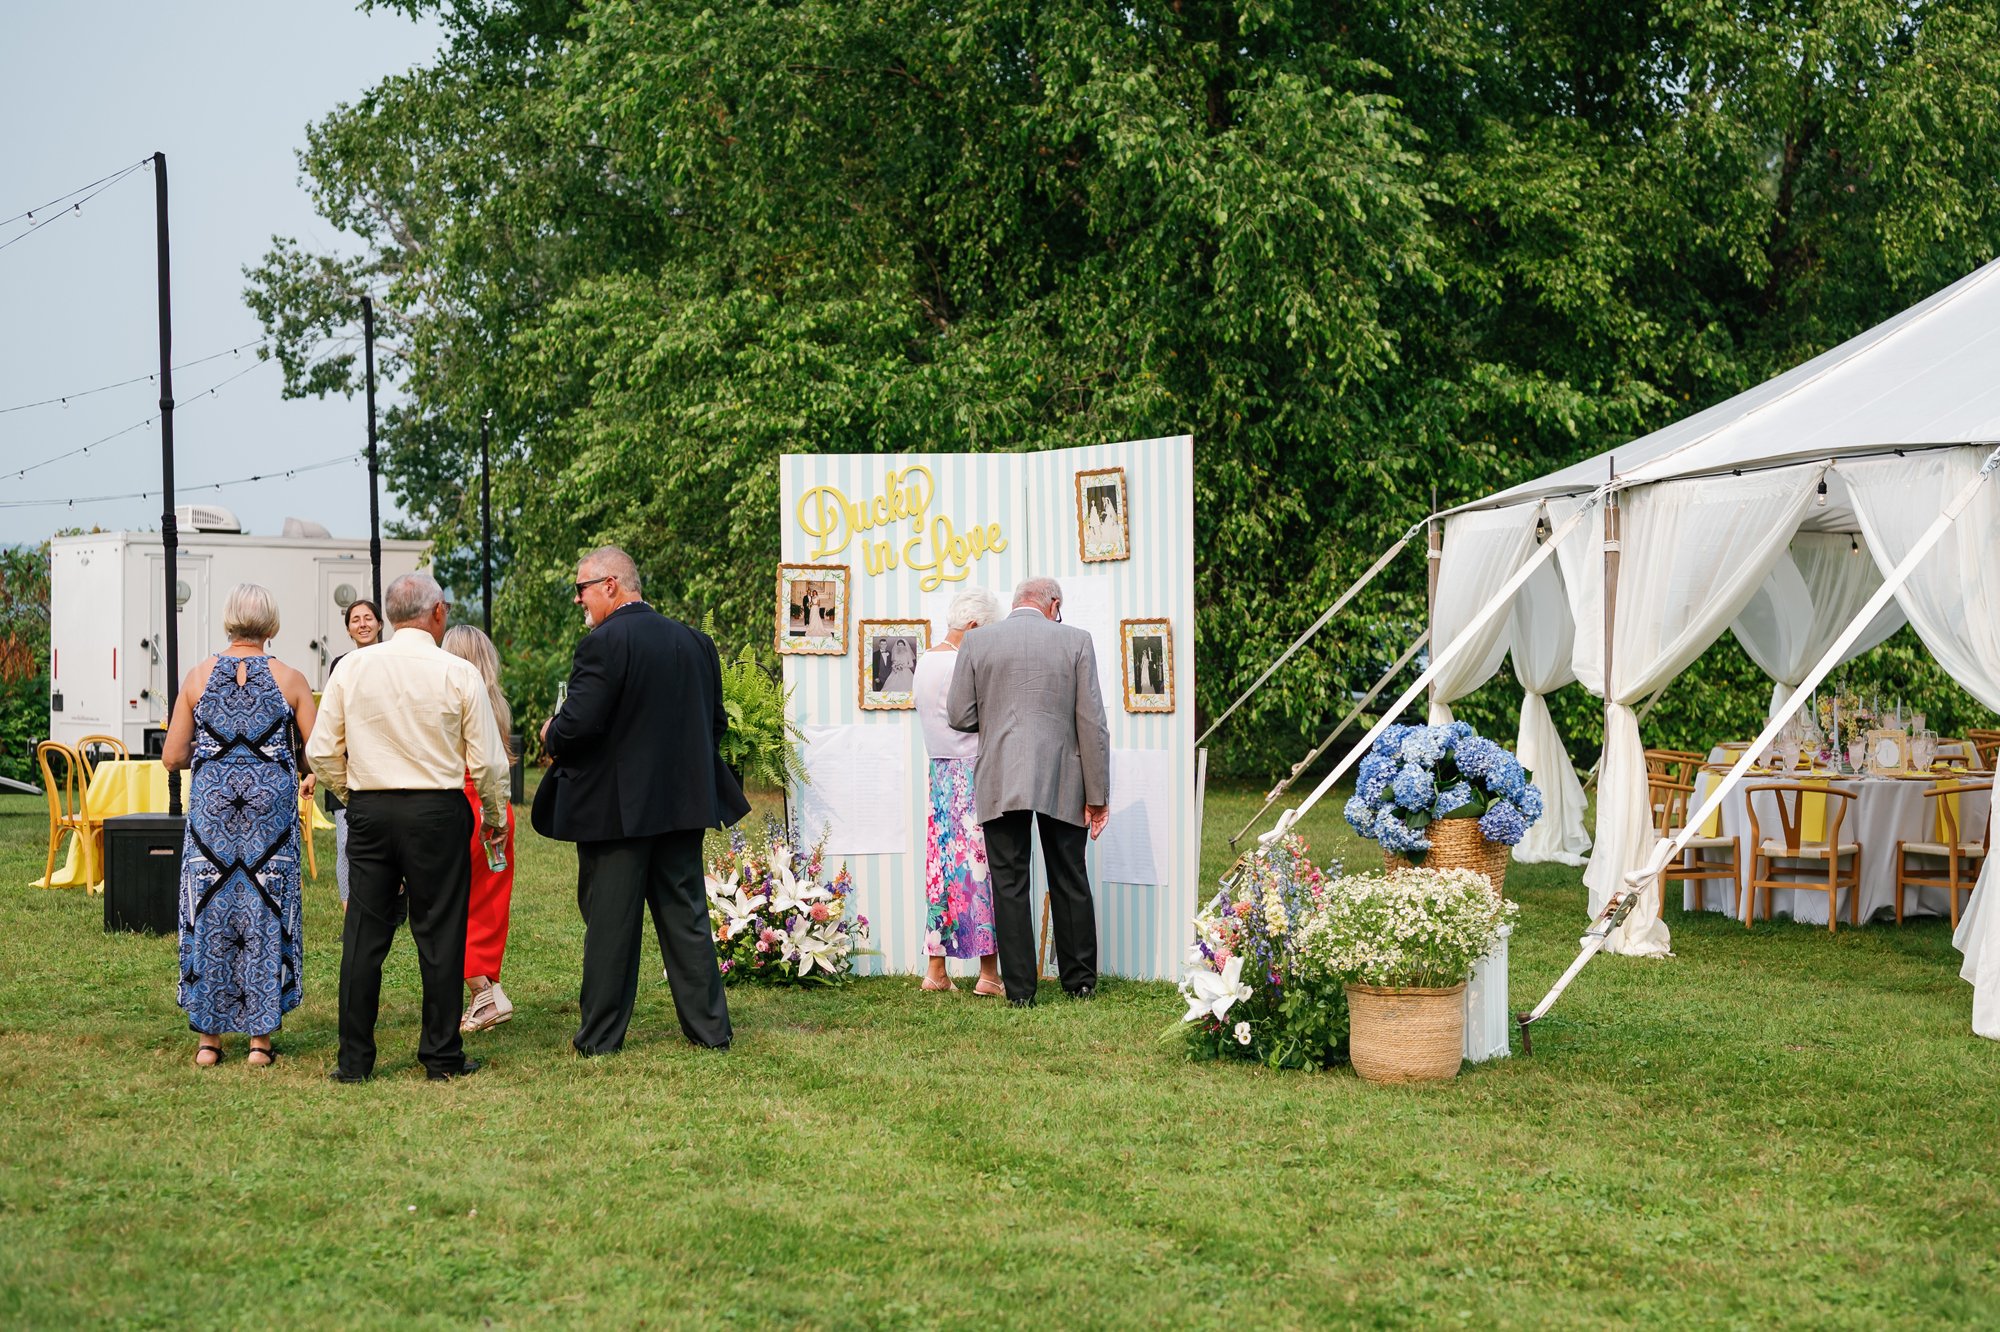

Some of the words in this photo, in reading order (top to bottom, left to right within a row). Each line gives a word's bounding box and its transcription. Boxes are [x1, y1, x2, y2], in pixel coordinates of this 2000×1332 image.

[797, 464, 934, 561] Ducky
[862, 539, 899, 576] in
[903, 514, 1008, 592] Love
